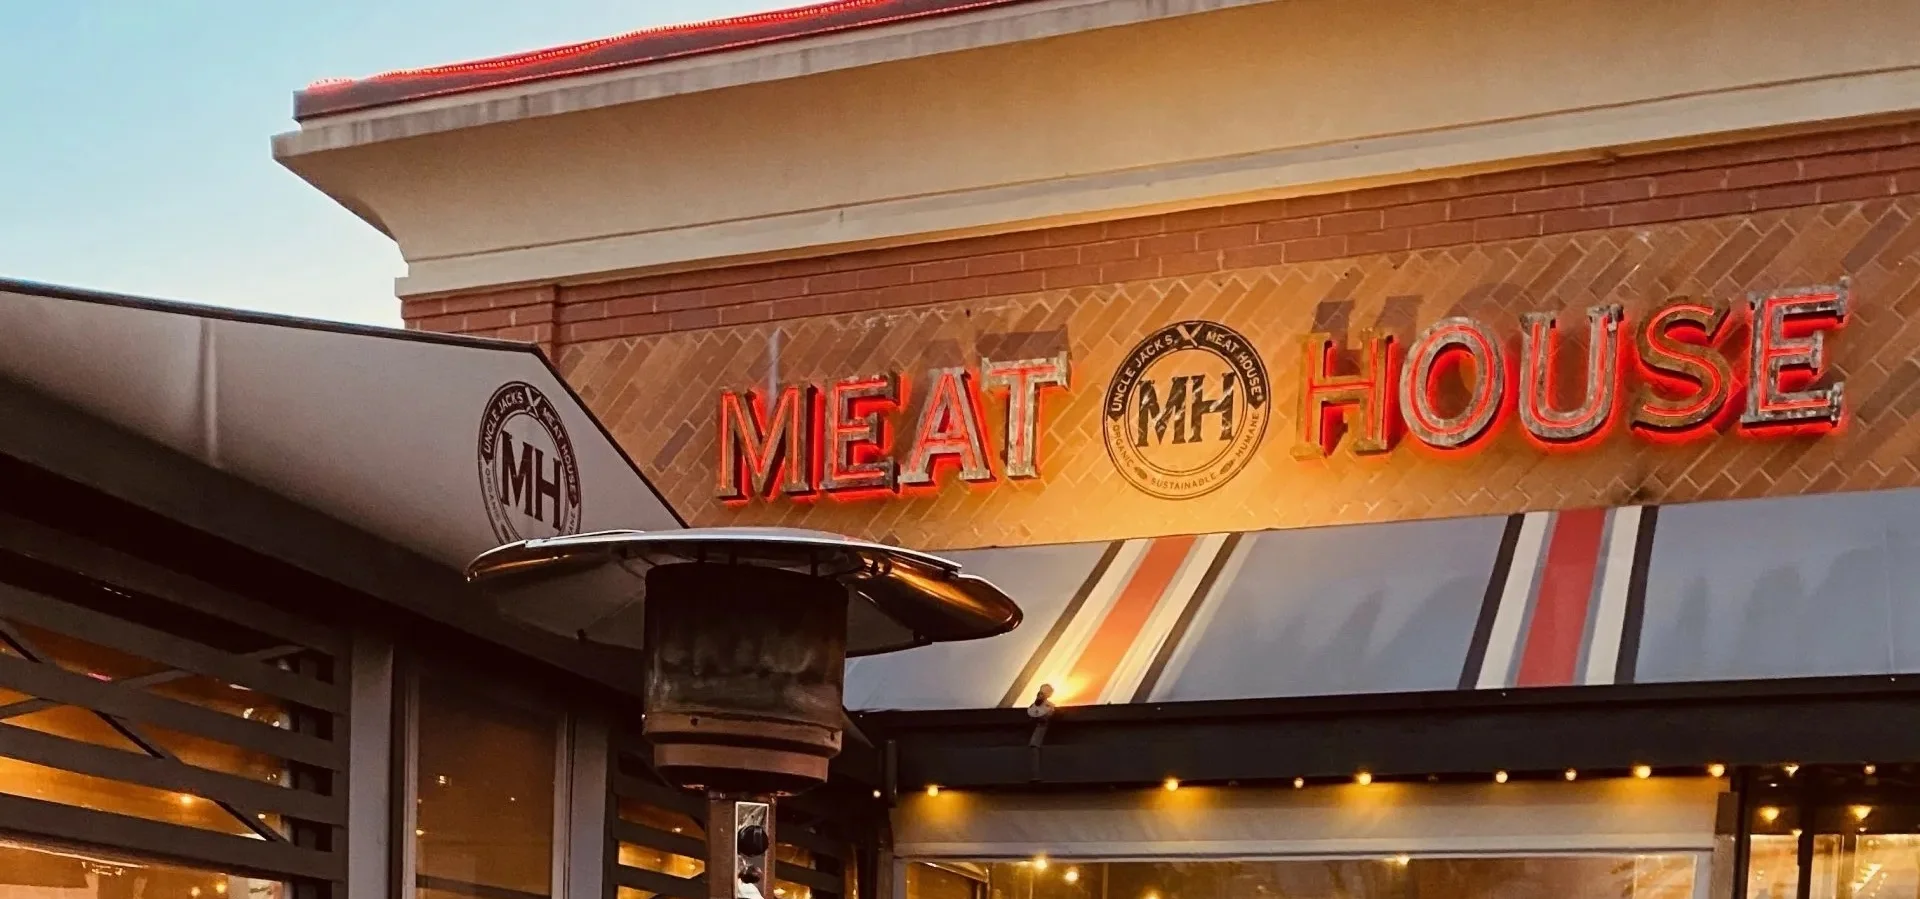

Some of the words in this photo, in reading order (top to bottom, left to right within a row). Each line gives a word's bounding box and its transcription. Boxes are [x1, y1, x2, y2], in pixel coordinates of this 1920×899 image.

[1206, 331, 1240, 353] MEAT
[714, 350, 1072, 501] MEAT
[1290, 276, 1850, 460] HOUSE
[1111, 366, 1136, 411] UNCLE
[1135, 371, 1237, 447] MH
[484, 409, 500, 454] UNCLE
[1112, 424, 1134, 467] ORGANIC
[1236, 413, 1260, 457] HUMANE
[500, 430, 562, 531] MH
[1151, 472, 1217, 490] SUSTAINABLE
